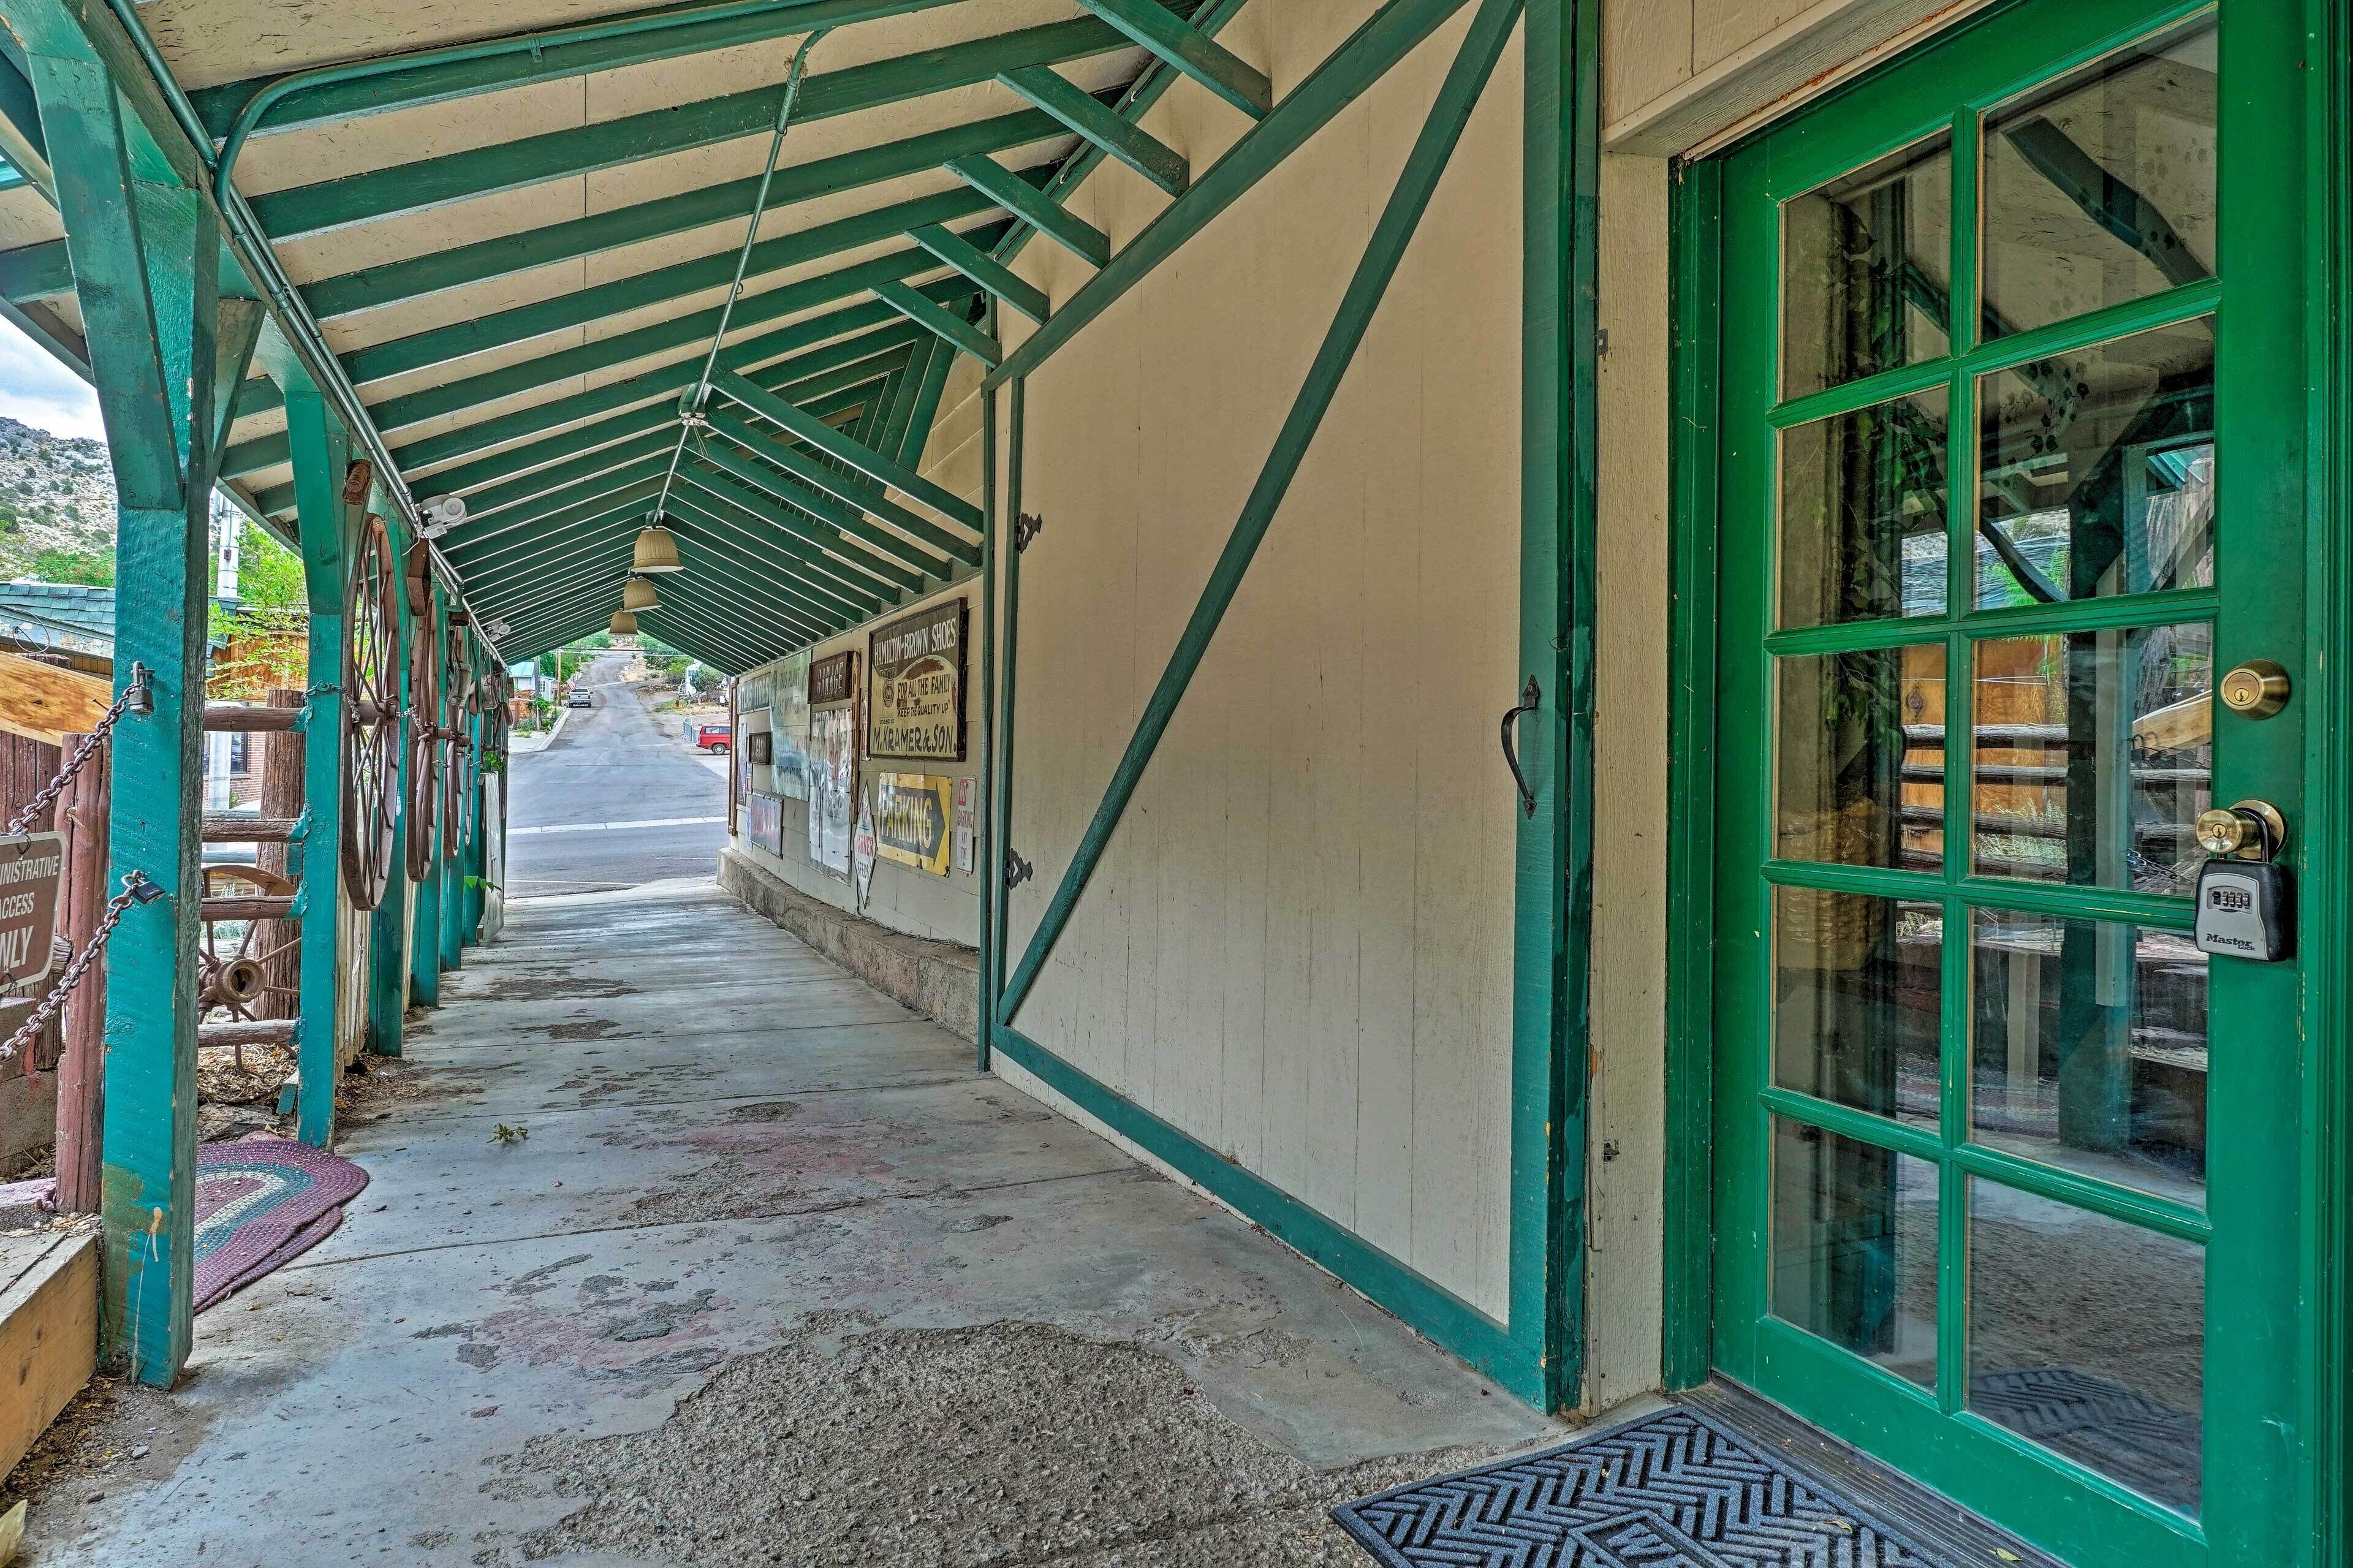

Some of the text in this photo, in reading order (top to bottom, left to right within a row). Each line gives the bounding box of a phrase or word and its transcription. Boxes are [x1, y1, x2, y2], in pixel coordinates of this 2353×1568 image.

[874, 617, 957, 667] HAMILTON-BROWN SHOES
[754, 677, 769, 706] TIRES
[817, 661, 844, 697] GARAGE
[897, 673, 951, 699] FOR ALL THE FAMILY
[917, 703, 941, 716] QUALITY
[959, 781, 967, 803] NO
[881, 793, 932, 849] PARKING
[958, 810, 973, 829] PARKING
[0, 855, 60, 886] INISTRATIVE
[2206, 933, 2253, 947] Master
